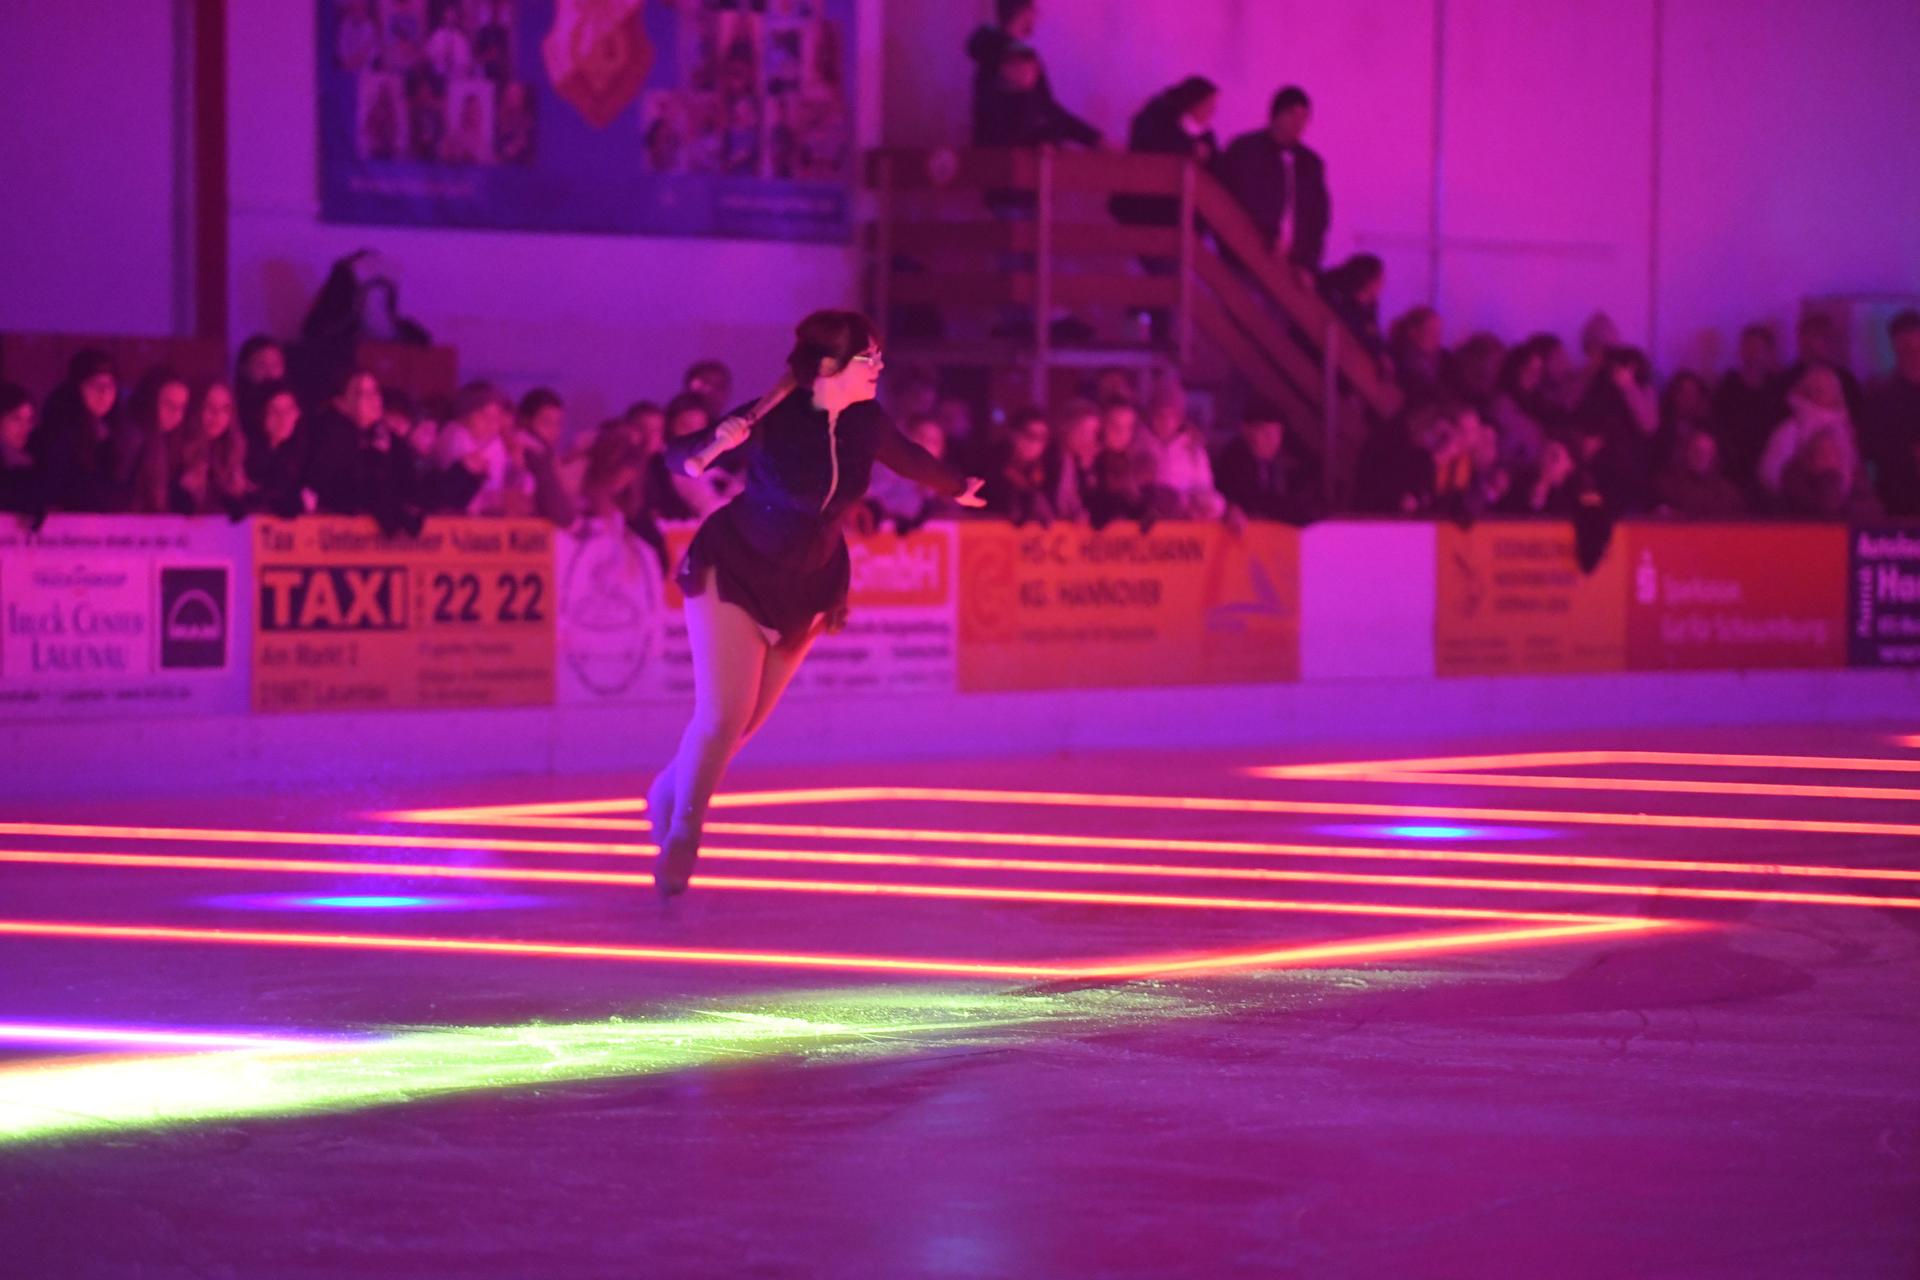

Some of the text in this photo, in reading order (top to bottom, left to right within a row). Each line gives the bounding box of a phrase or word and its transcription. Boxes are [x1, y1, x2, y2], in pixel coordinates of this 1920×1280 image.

[262, 570, 403, 627] TAXI
[433, 572, 481, 622] 22
[496, 572, 544, 622] 22
